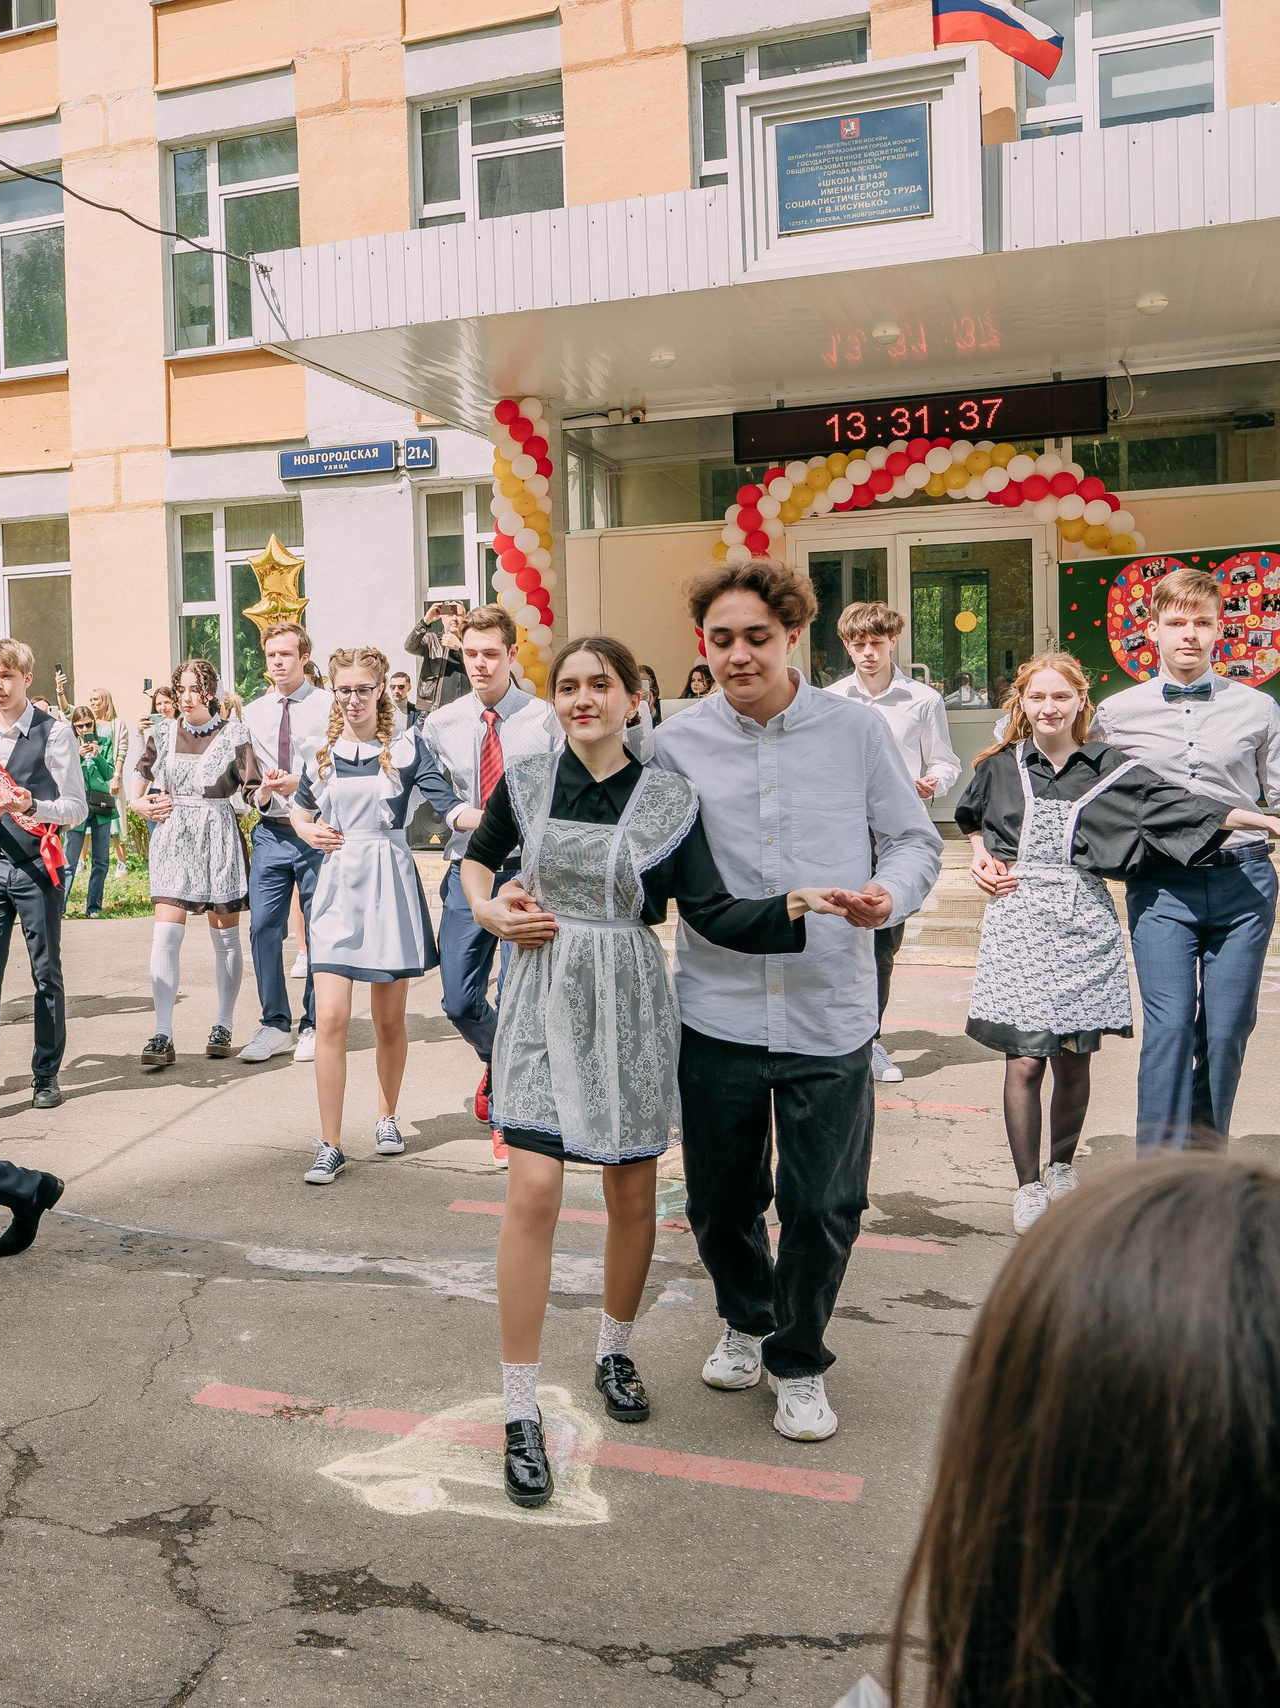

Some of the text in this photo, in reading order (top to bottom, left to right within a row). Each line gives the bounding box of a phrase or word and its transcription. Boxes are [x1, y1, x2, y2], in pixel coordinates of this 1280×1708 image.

[787, 151, 827, 161] ДЕПАРТАМЕНТ
[827, 145, 869, 155] ОБРАЗОВАНИЯ
[868, 141, 892, 149] ГОРОДА
[815, 135, 888, 150] ПРАВИТЕЛЬСТВО МОСКВЫ
[785, 151, 920, 175] ОБЩЕОБРАЗОВАТЕЛЬНОЕ УЧРЕЖДЕНИЕ
[796, 146, 908, 167] ГОСУДАРСТВЕННОЕ БЮДЖЕТНОЕ
[817, 171, 888, 188] «ШКОЛА №1430
[823, 164, 882, 177] ГОРОДА МОСКВЫ
[785, 184, 923, 210] СОЦИАЛИСТИЧЕСКОГО ТРУДА
[820, 180, 886, 196] ИМЕНИ ГЕРОЯ
[818, 199, 889, 214] Г.В.КИСУНЬКО»
[826, 398, 1003, 443] 13:31:37
[293, 447, 379, 466] НОВГОРОДСКАЯ
[323, 463, 349, 471] УЛИЦА
